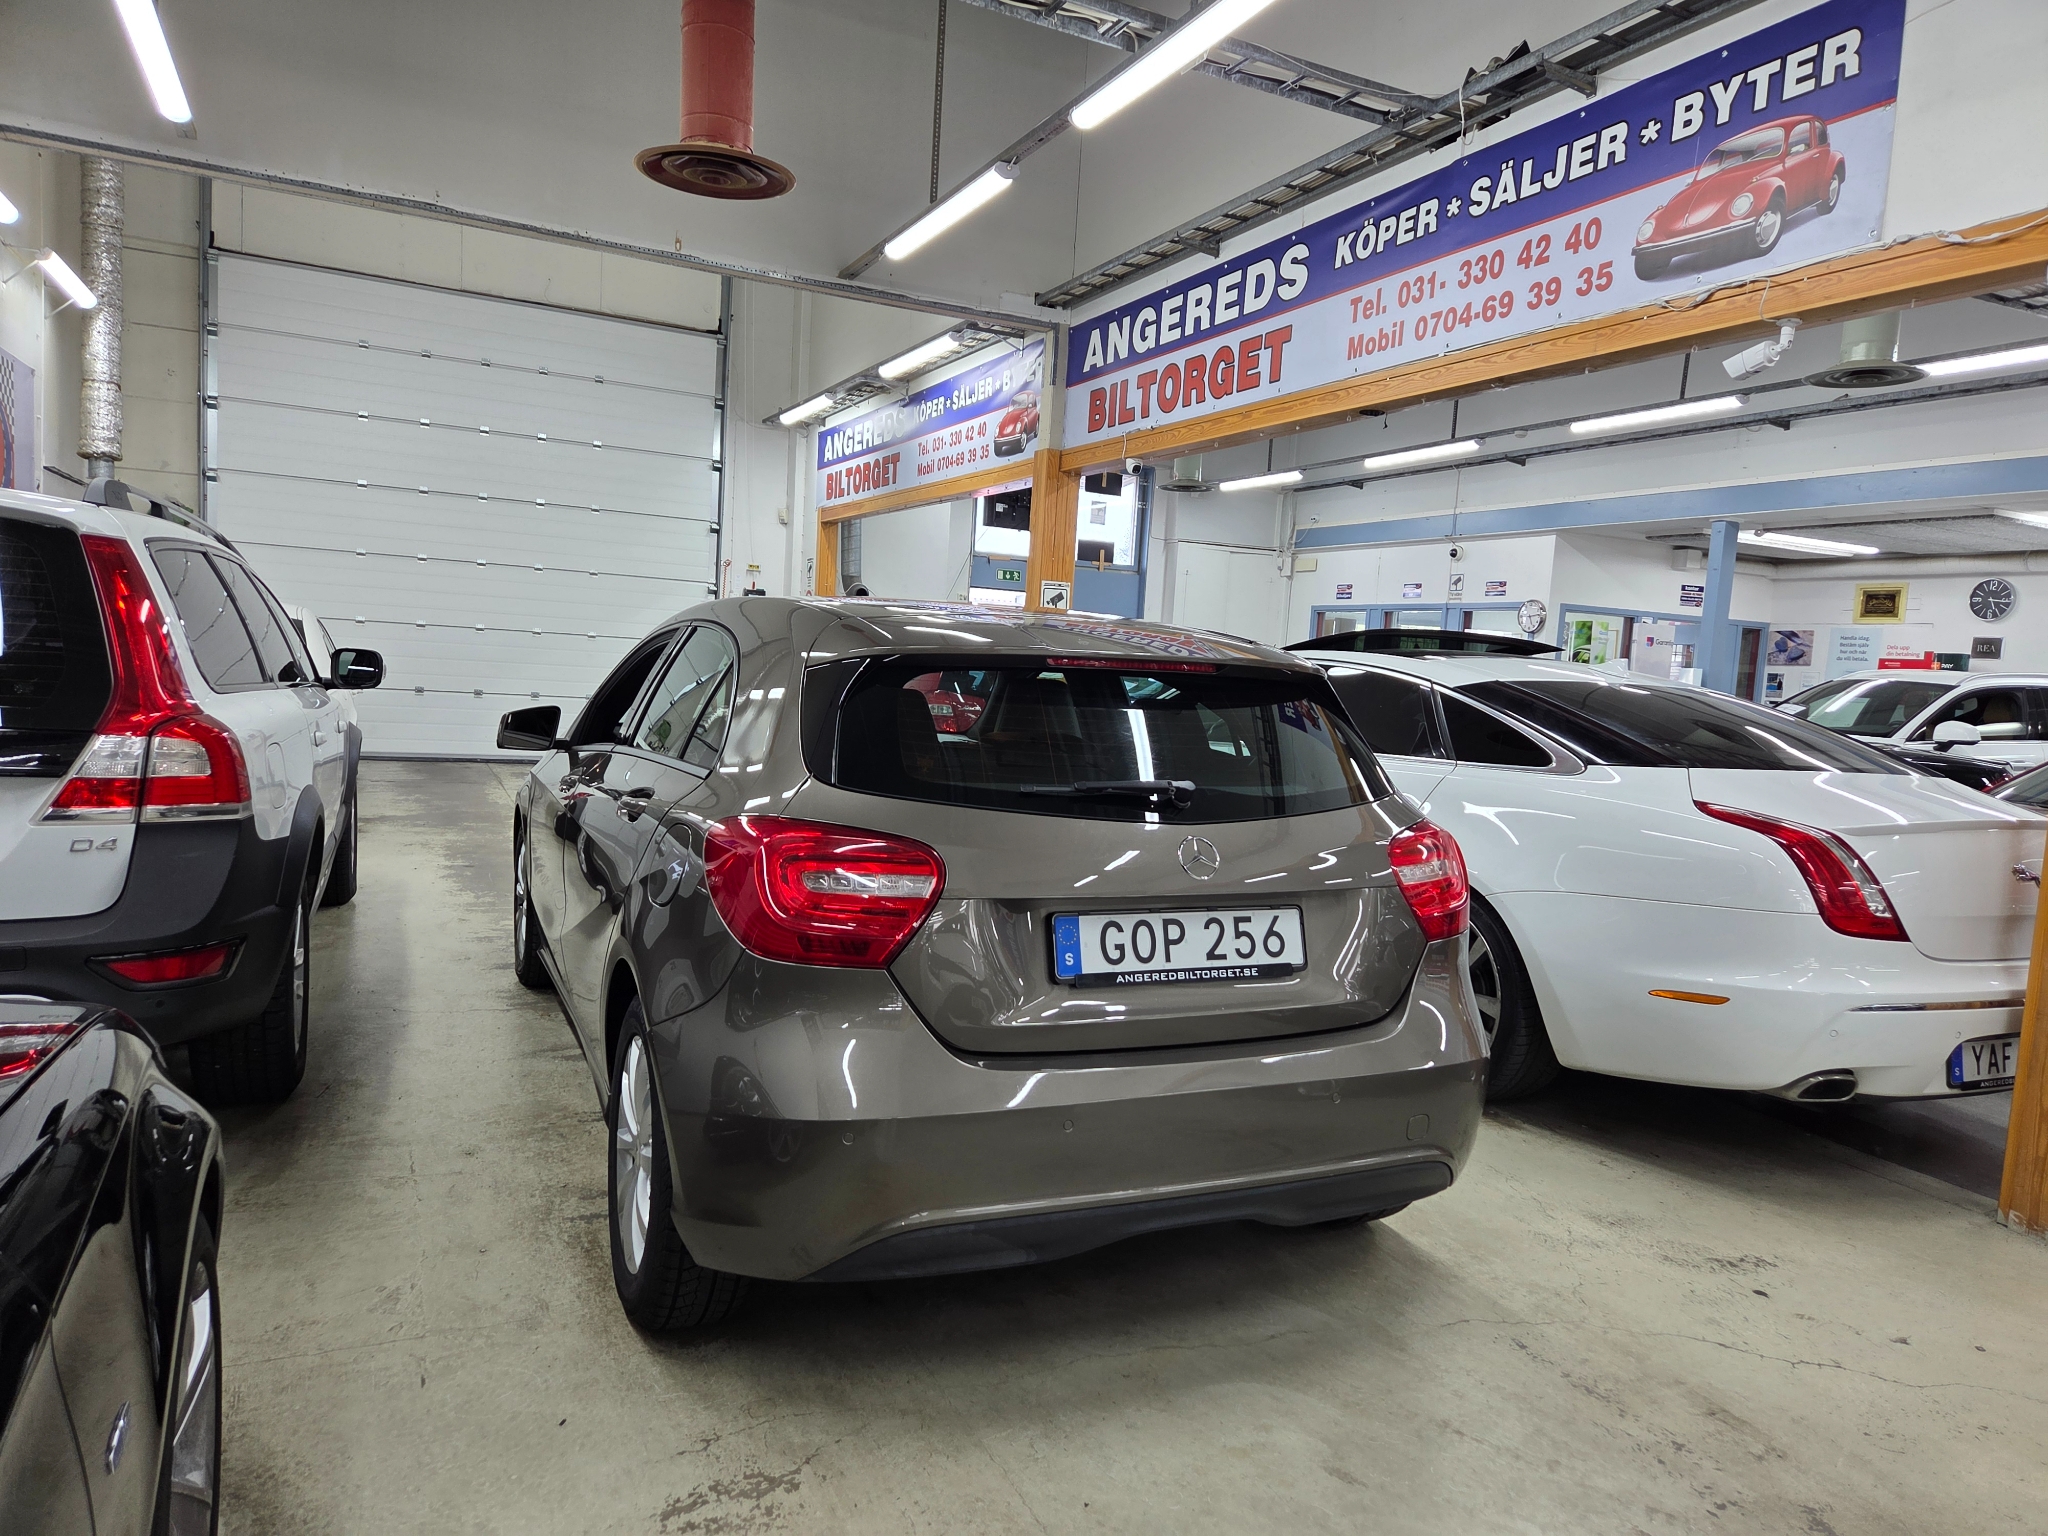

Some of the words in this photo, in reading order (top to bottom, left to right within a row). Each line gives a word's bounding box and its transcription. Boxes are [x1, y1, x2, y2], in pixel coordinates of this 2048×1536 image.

[1332, 197, 1439, 271] KÖPER
[1468, 120, 1629, 218] SÄLJER
[1671, 27, 1863, 142] BYTER
[1349, 294, 1389, 325] Tel.
[1398, 271, 1448, 311] 031-
[1458, 253, 1506, 291] 330
[1517, 235, 1552, 270] 42
[1564, 216, 1603, 255] 40
[1082, 243, 1310, 374] ANGEREDS
[1347, 320, 1404, 360] Mobil
[1413, 290, 1515, 339] 0704-69
[1526, 276, 1565, 312] 39
[1575, 260, 1615, 295] 35
[913, 396, 945, 424] KÖPER
[952, 376, 993, 411] SÄLJER
[1087, 323, 1293, 433] BILTORGET
[823, 406, 907, 463] ANGEREDS
[917, 442, 930, 456] Tel.
[949, 432, 962, 446] 330
[965, 426, 975, 442] 42
[977, 421, 987, 438] 40
[826, 452, 901, 501] BILTORGET
[917, 460, 934, 477] Mobil
[937, 452, 965, 472] 0704-69
[967, 448, 977, 464] 39
[979, 444, 990, 460] 35
[1976, 644, 1996, 653] REA
[69, 836, 118, 853] D4
[1064, 952, 1074, 966] S
[1099, 917, 1186, 966] GOP
[1203, 914, 1286, 962] 256
[1115, 967, 1259, 984] ANGEREDBILTORGET.SE
[1971, 1042, 2012, 1076] YAF
